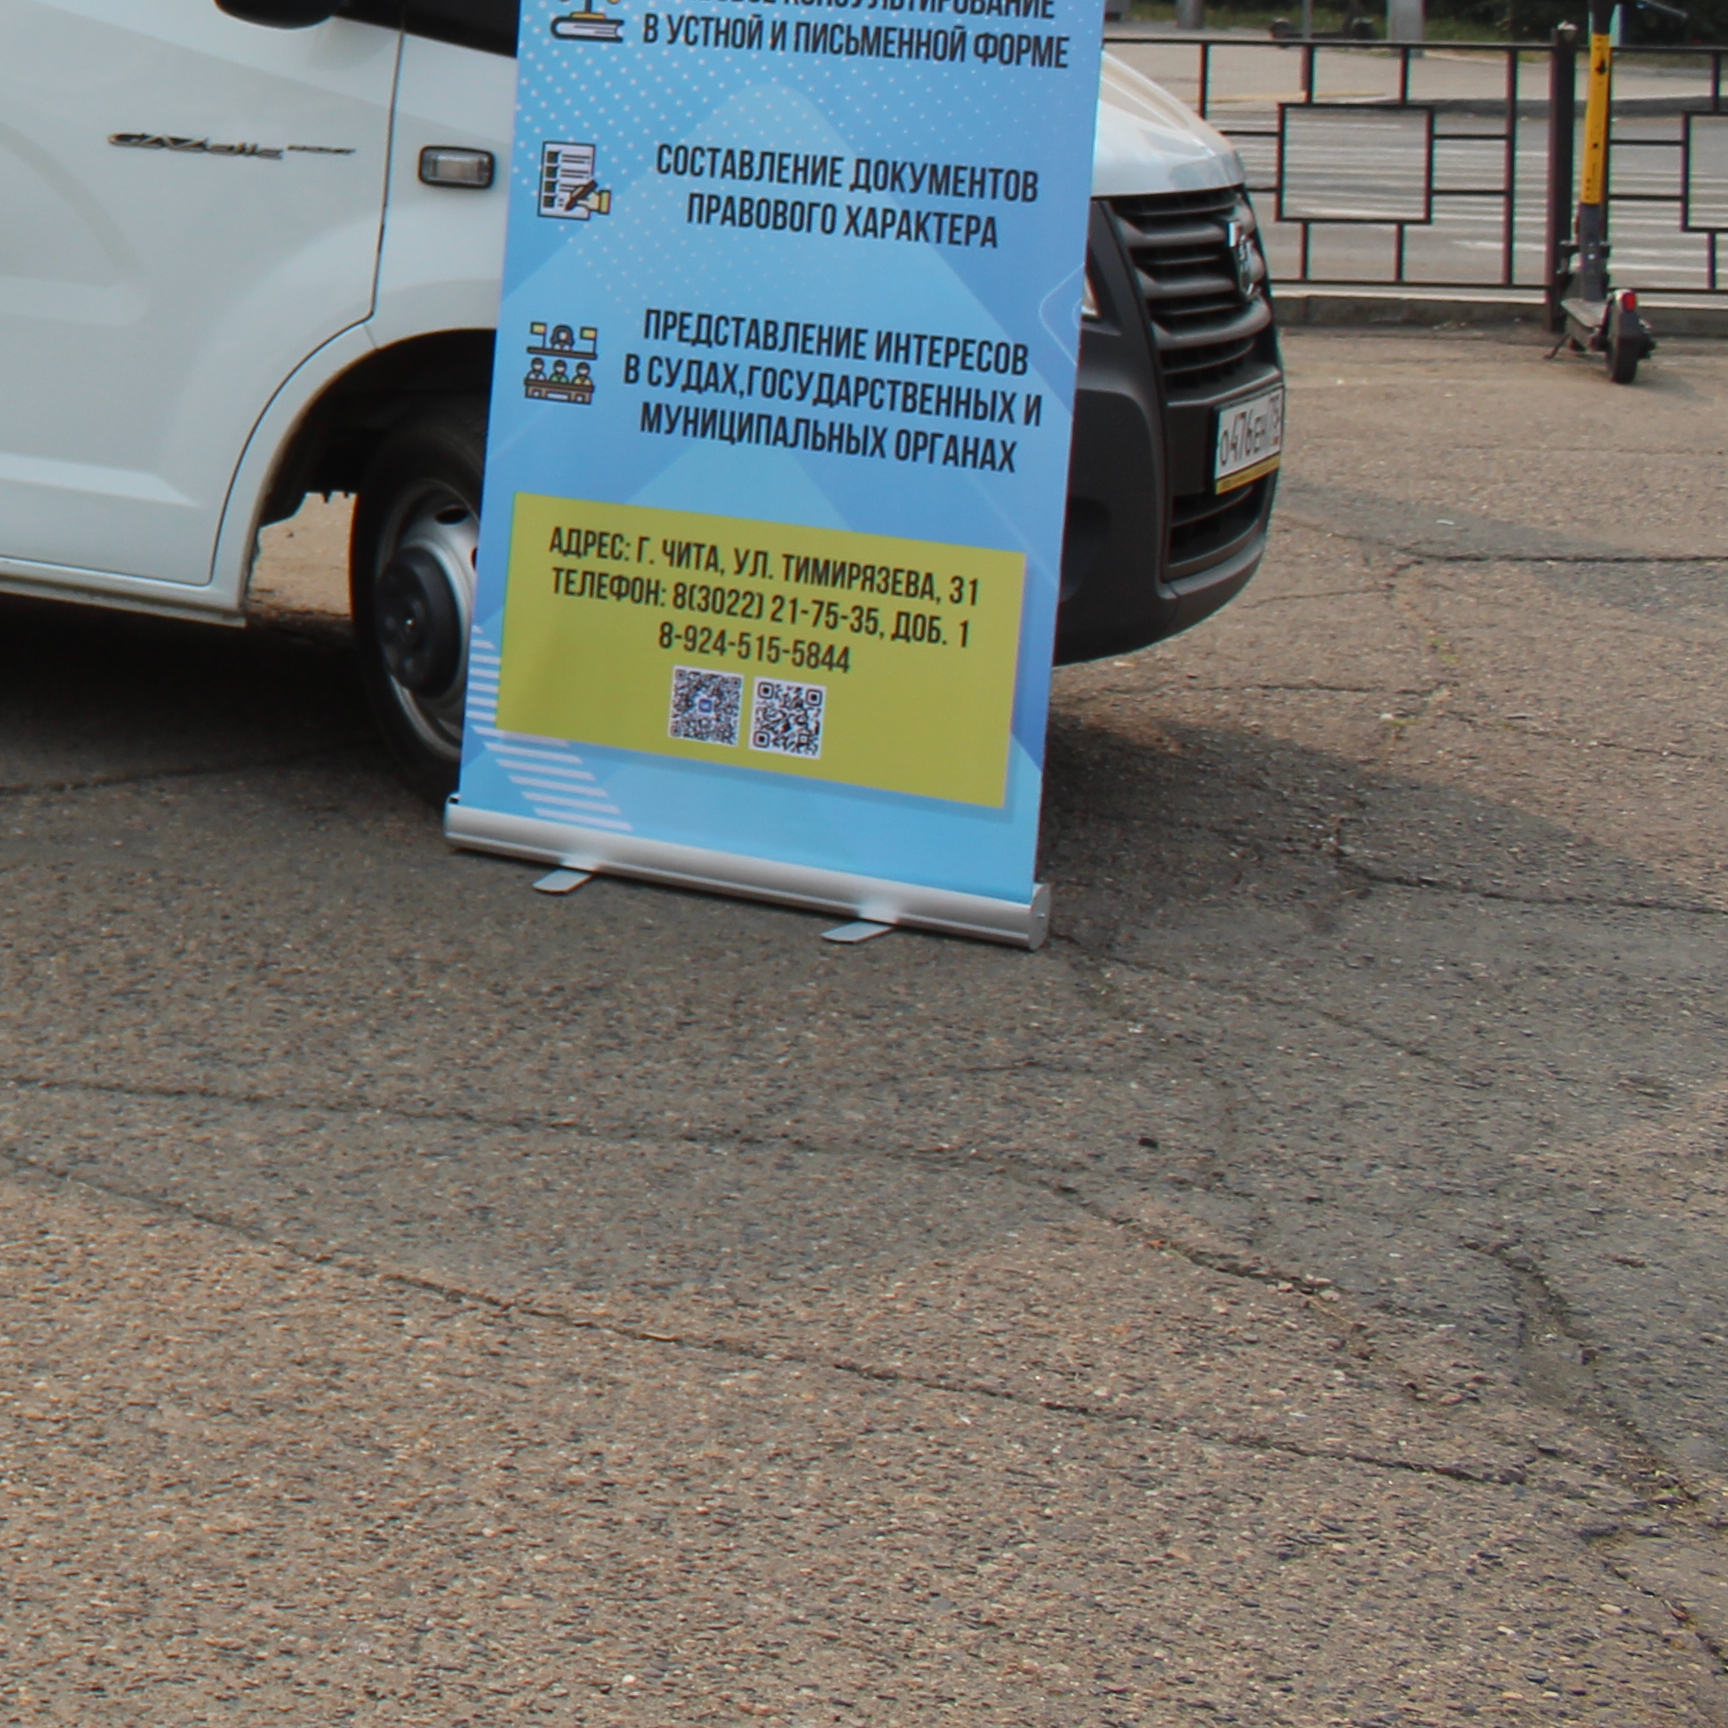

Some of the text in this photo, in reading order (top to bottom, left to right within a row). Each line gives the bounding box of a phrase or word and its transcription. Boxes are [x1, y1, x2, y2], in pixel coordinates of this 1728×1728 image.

[643, 10, 1070, 69] В УСТНОЙ И ПИСЬМЕННОЙ ФОРМЕ
[655, 144, 1039, 204] СОСТАВЛЕНИЕ ДОКУМЕНТОВ
[687, 193, 999, 249] ПРАВОВОГО ХАРАКТЕРА
[643, 309, 1029, 376] ПРЕДСТАВЛЕНИЕ ИНТЕРЕСОВ
[624, 355, 640, 384] В
[1024, 395, 1042, 427] И
[639, 402, 1017, 473] МУНИЦИПАЛЬНЫХ ОРГАНАХ
[549, 526, 980, 606] АДРЕС: Г. ЧИТА, УЛ. ТИМИРЯЗЕВА, 31
[553, 566, 970, 648] ТЕЛЕФОН: 8(3022) 21-75-35, ДОБ. 1
[659, 622, 852, 673] 8-924-515-5844
